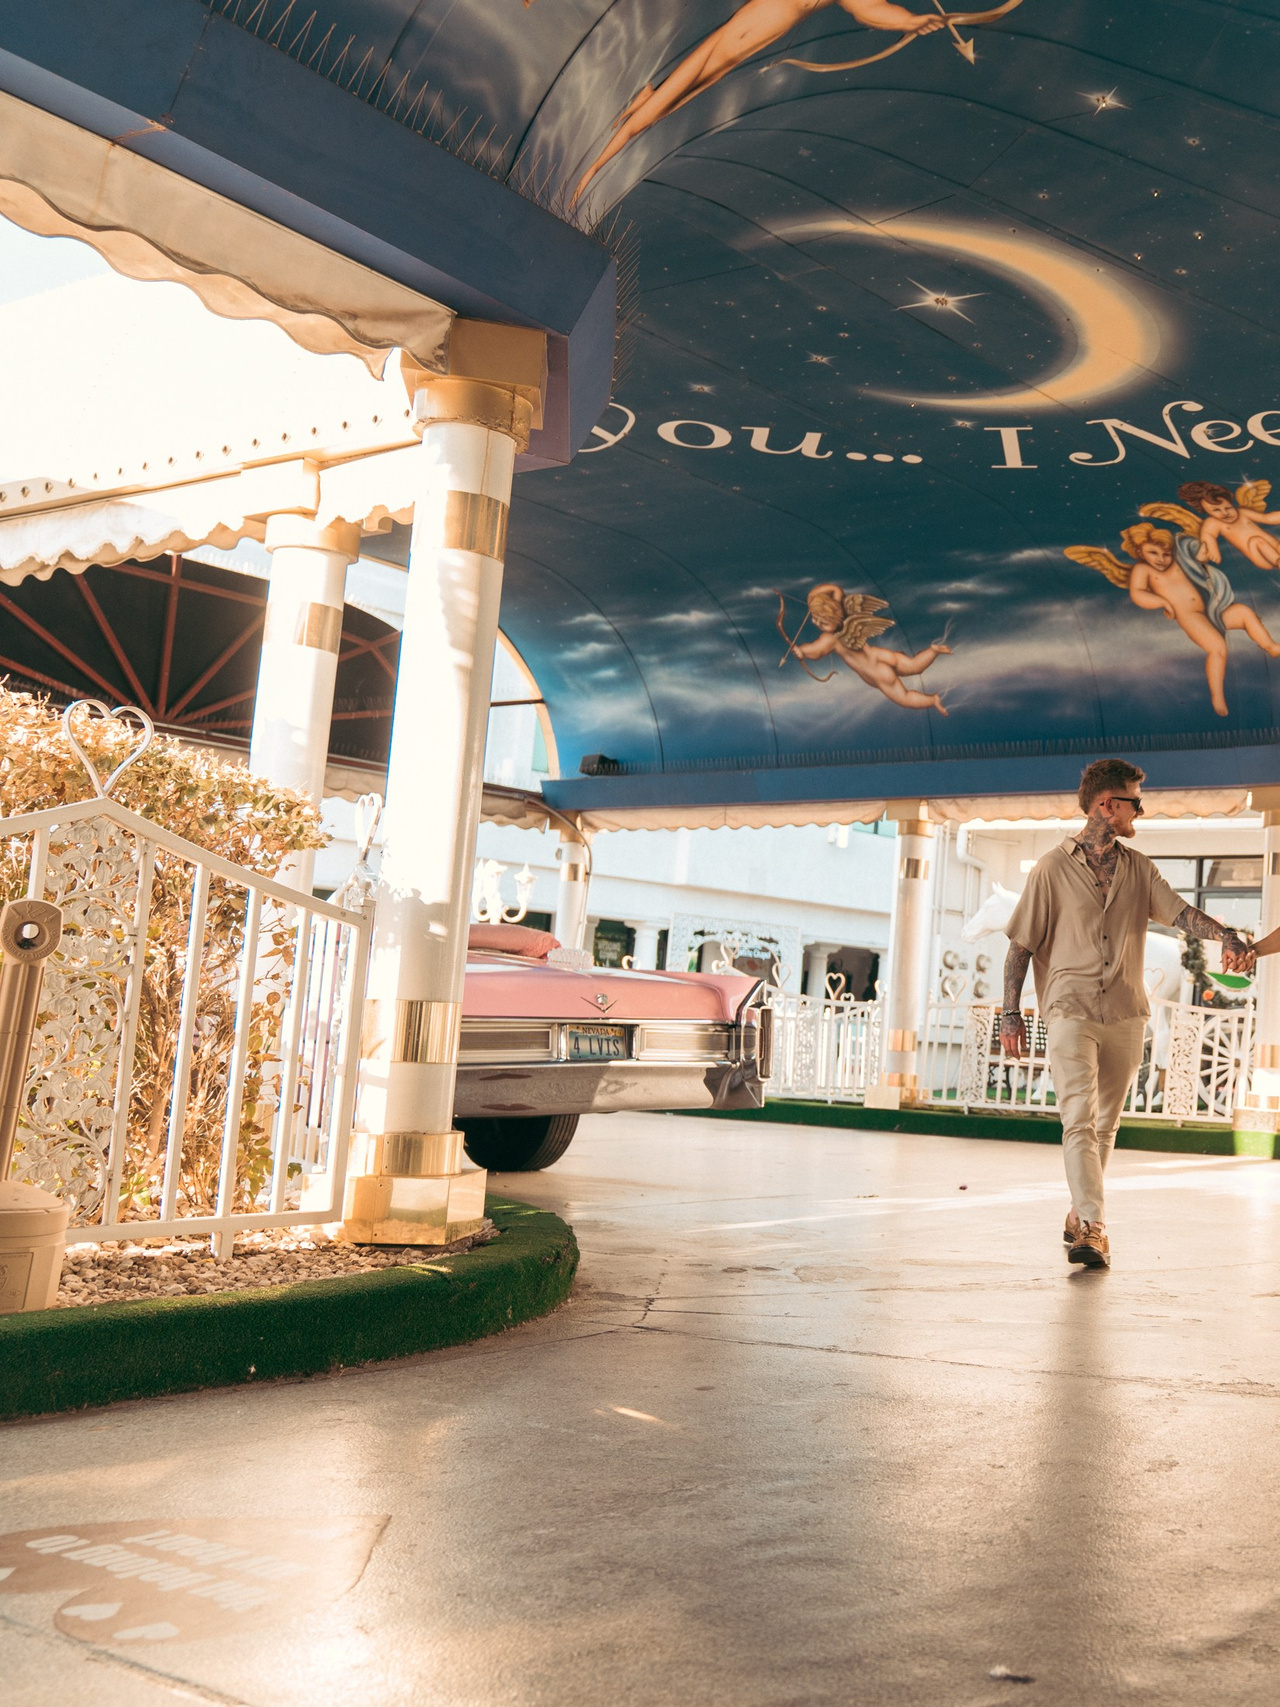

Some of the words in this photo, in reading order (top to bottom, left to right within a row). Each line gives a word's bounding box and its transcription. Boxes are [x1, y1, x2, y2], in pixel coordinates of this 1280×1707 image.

[983, 426, 1038, 469] I
[582, 1026, 609, 1036] NEVADA
[573, 1036, 580, 1055] 4
[589, 1037, 620, 1056] LVIS
[25, 1534, 92, 1555] to
[121, 1529, 250, 1566] heart
[60, 1543, 216, 1592] belong
